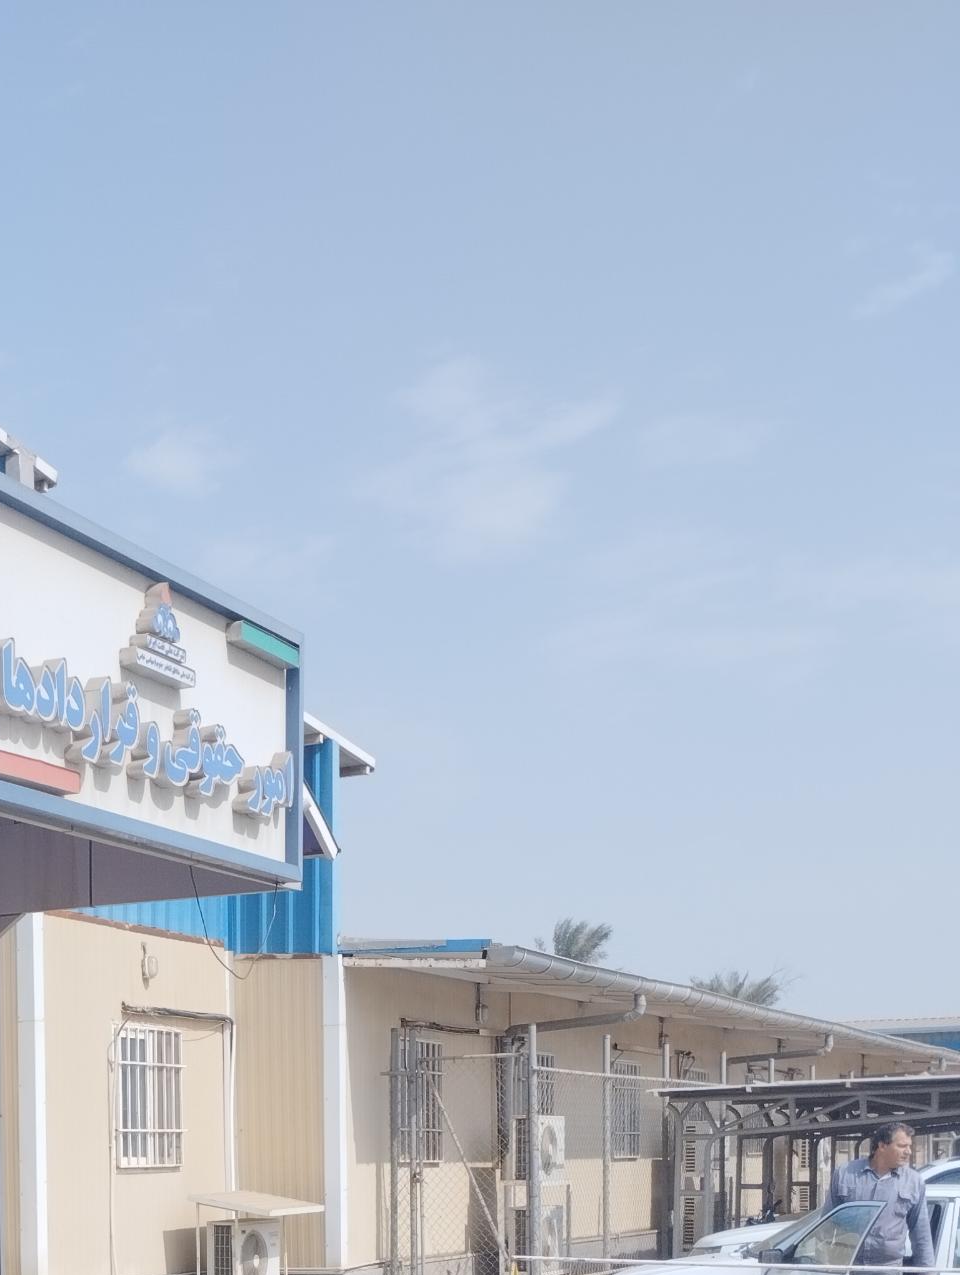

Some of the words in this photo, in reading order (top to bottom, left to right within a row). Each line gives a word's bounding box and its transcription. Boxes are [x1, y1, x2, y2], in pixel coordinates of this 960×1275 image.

[143, 721, 160, 778] و
[164, 708, 245, 796] حقوقی
[248, 752, 294, 816] امور
